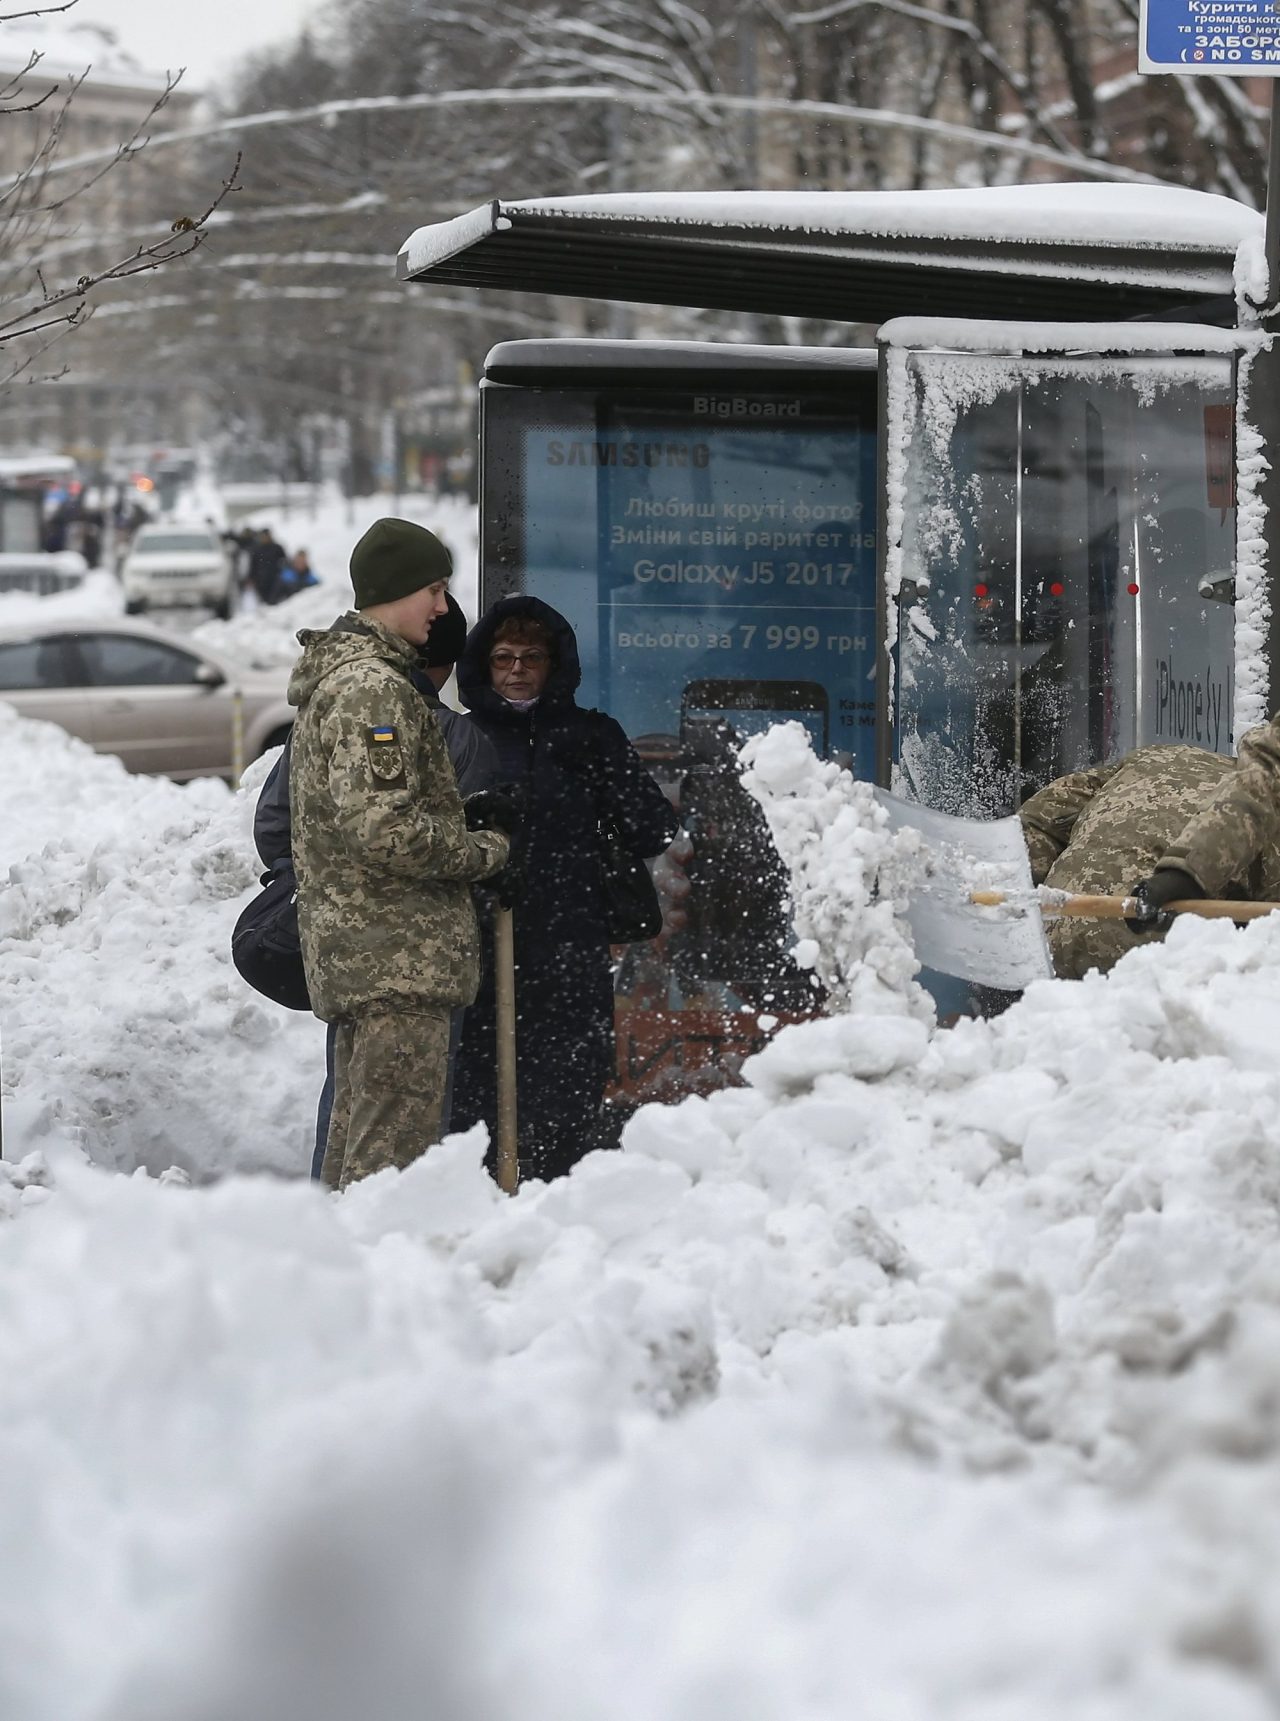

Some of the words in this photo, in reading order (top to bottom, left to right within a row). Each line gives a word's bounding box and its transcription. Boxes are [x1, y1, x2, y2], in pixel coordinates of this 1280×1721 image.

[1188, 1, 1258, 14] Курити
[1264, 4, 1280, 13] н
[1178, 25, 1192, 33] та
[1195, 25, 1203, 33] в
[1207, 25, 1233, 34] зоні
[1237, 25, 1252, 34] 50
[1211, 49, 1242, 60] NO
[692, 397, 803, 418] BigBoard
[546, 440, 711, 469] SAMSUNG
[623, 497, 716, 518] Любиш
[722, 500, 785, 523] круті
[791, 500, 864, 524] фото?
[610, 525, 681, 545] Зміни
[688, 526, 738, 546] свій
[744, 531, 843, 551] раритет
[849, 533, 876, 549] на
[633, 559, 740, 589] Galaxy
[743, 561, 775, 585] J5
[785, 561, 853, 586] 2017
[617, 631, 700, 649] всього
[706, 633, 732, 649] за
[739, 625, 757, 649] 7
[765, 625, 820, 650] 999
[826, 635, 867, 655] грн
[1155, 654, 1203, 743] iPhone
[841, 714, 855, 727] 13
